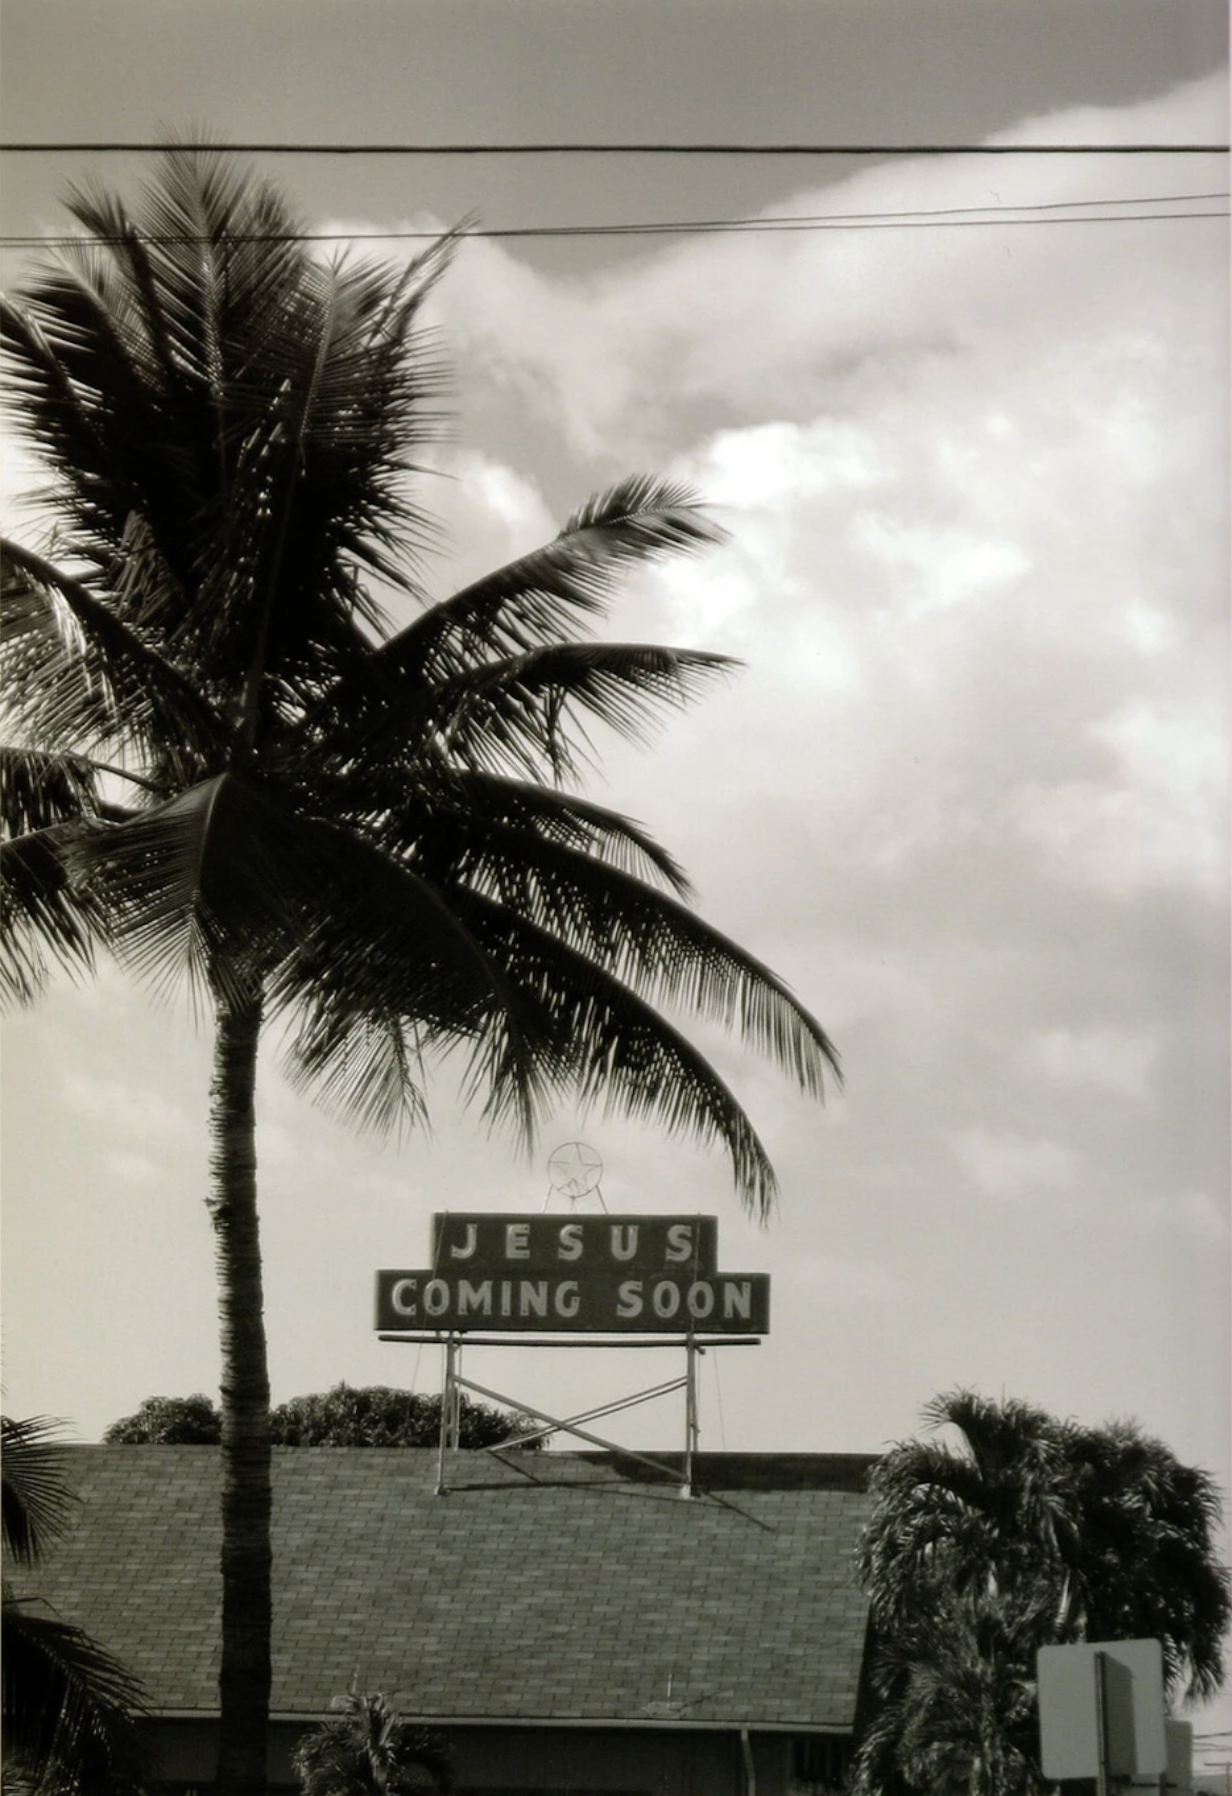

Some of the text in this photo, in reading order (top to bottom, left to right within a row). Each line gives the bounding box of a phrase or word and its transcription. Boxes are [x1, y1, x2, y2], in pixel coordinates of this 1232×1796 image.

[451, 1223, 693, 1262] JESUS
[391, 1278, 752, 1319] COMING SOON
